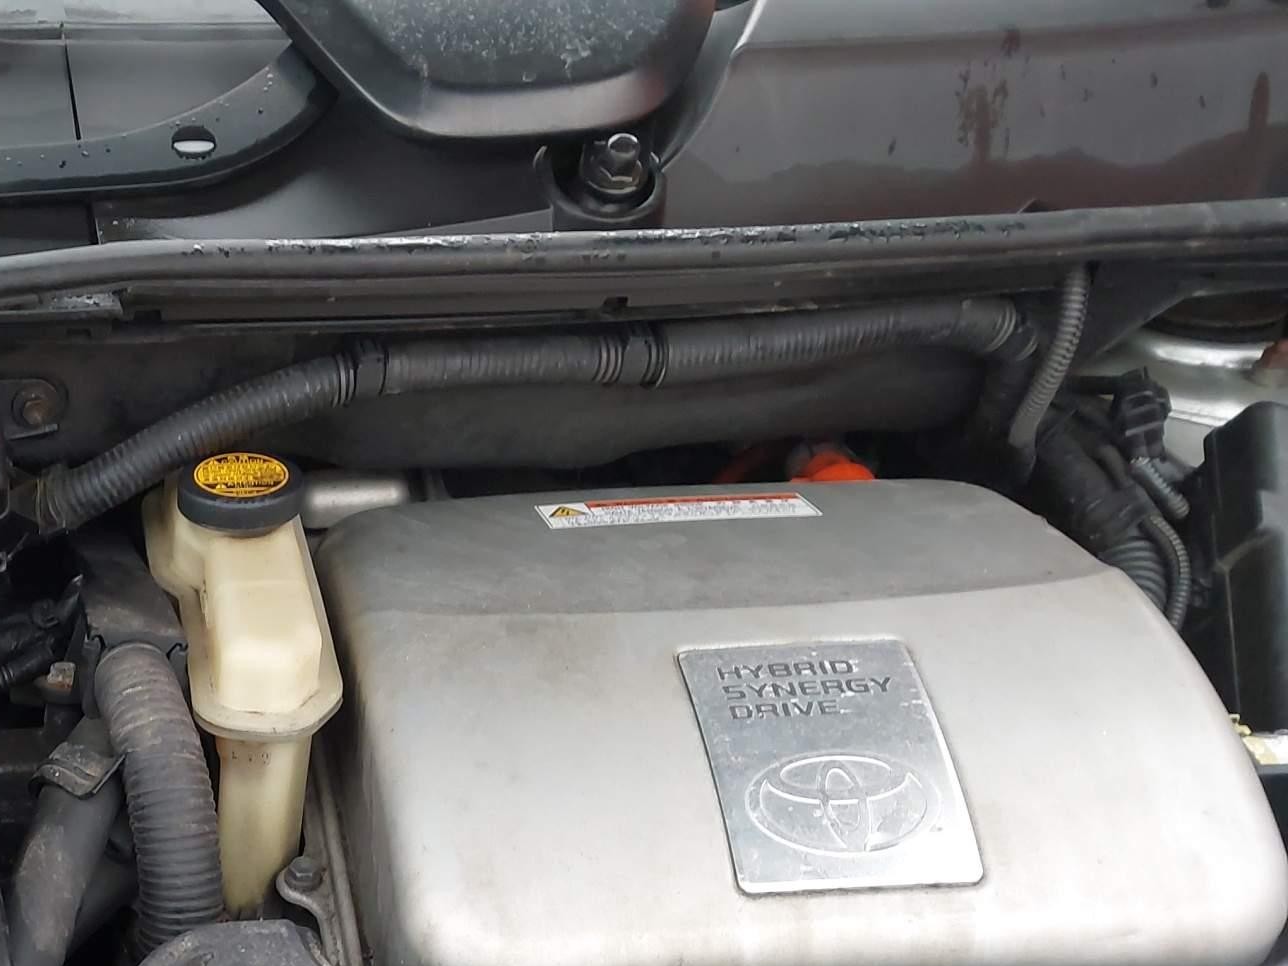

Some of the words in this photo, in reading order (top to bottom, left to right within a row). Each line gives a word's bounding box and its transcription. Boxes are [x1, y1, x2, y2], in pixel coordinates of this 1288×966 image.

[717, 658, 853, 681] HYBRID
[722, 677, 892, 700] SYNERGY
[728, 699, 841, 721] DRIVE
